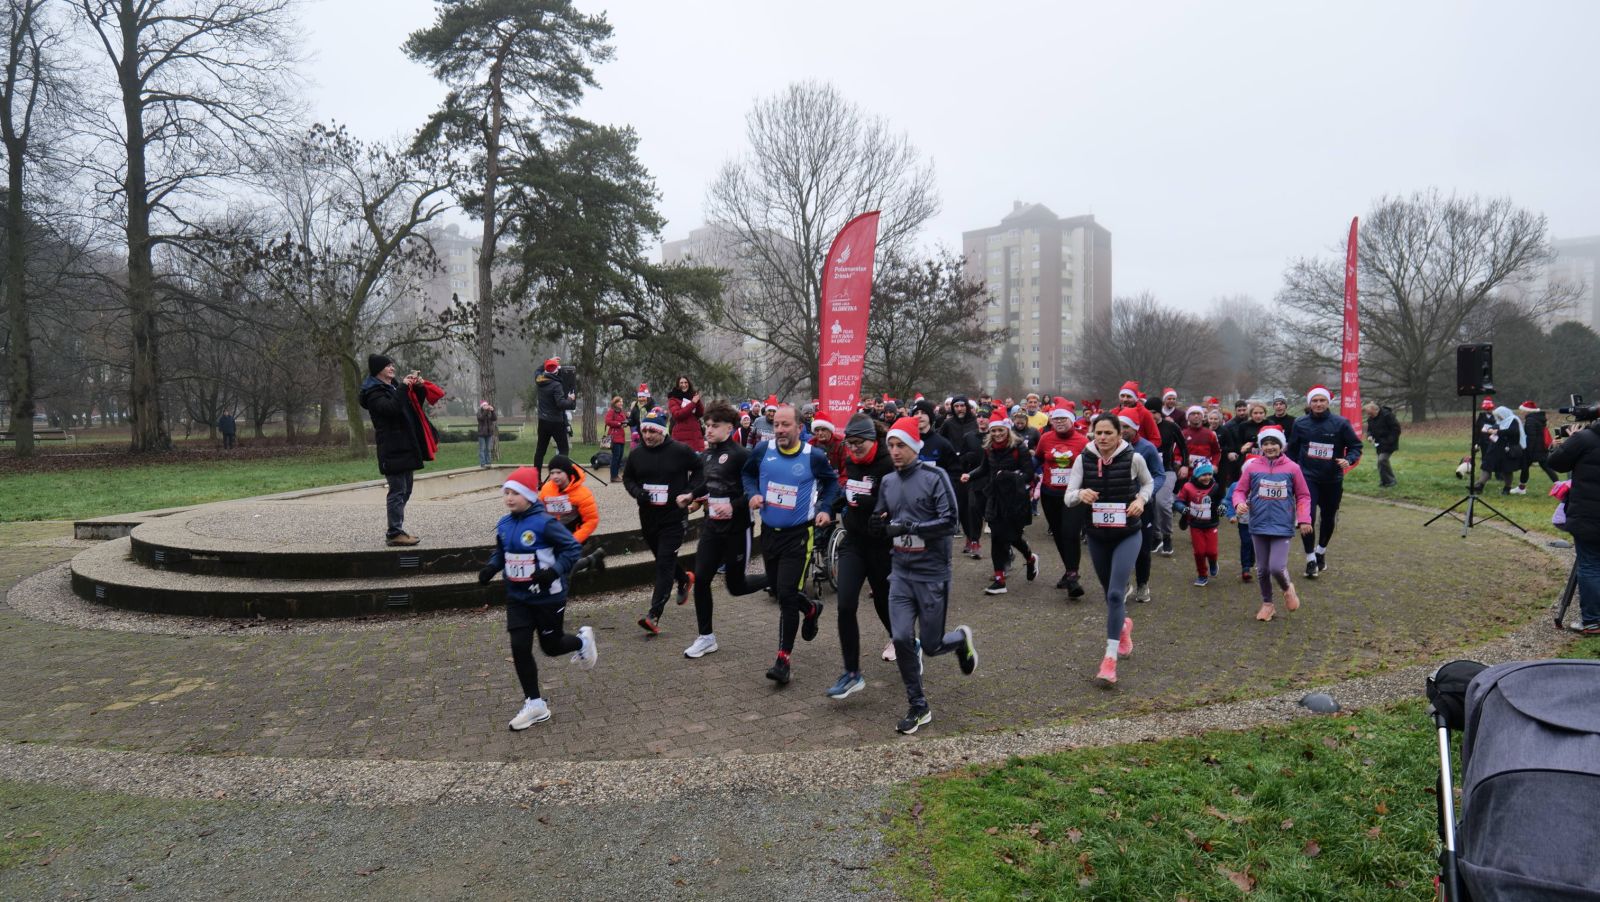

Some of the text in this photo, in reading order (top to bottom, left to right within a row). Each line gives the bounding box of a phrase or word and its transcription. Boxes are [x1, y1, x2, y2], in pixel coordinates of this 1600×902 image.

[1266, 488, 1282, 498] 190
[777, 494, 783, 504] 5
[1103, 512, 1115, 523] 85
